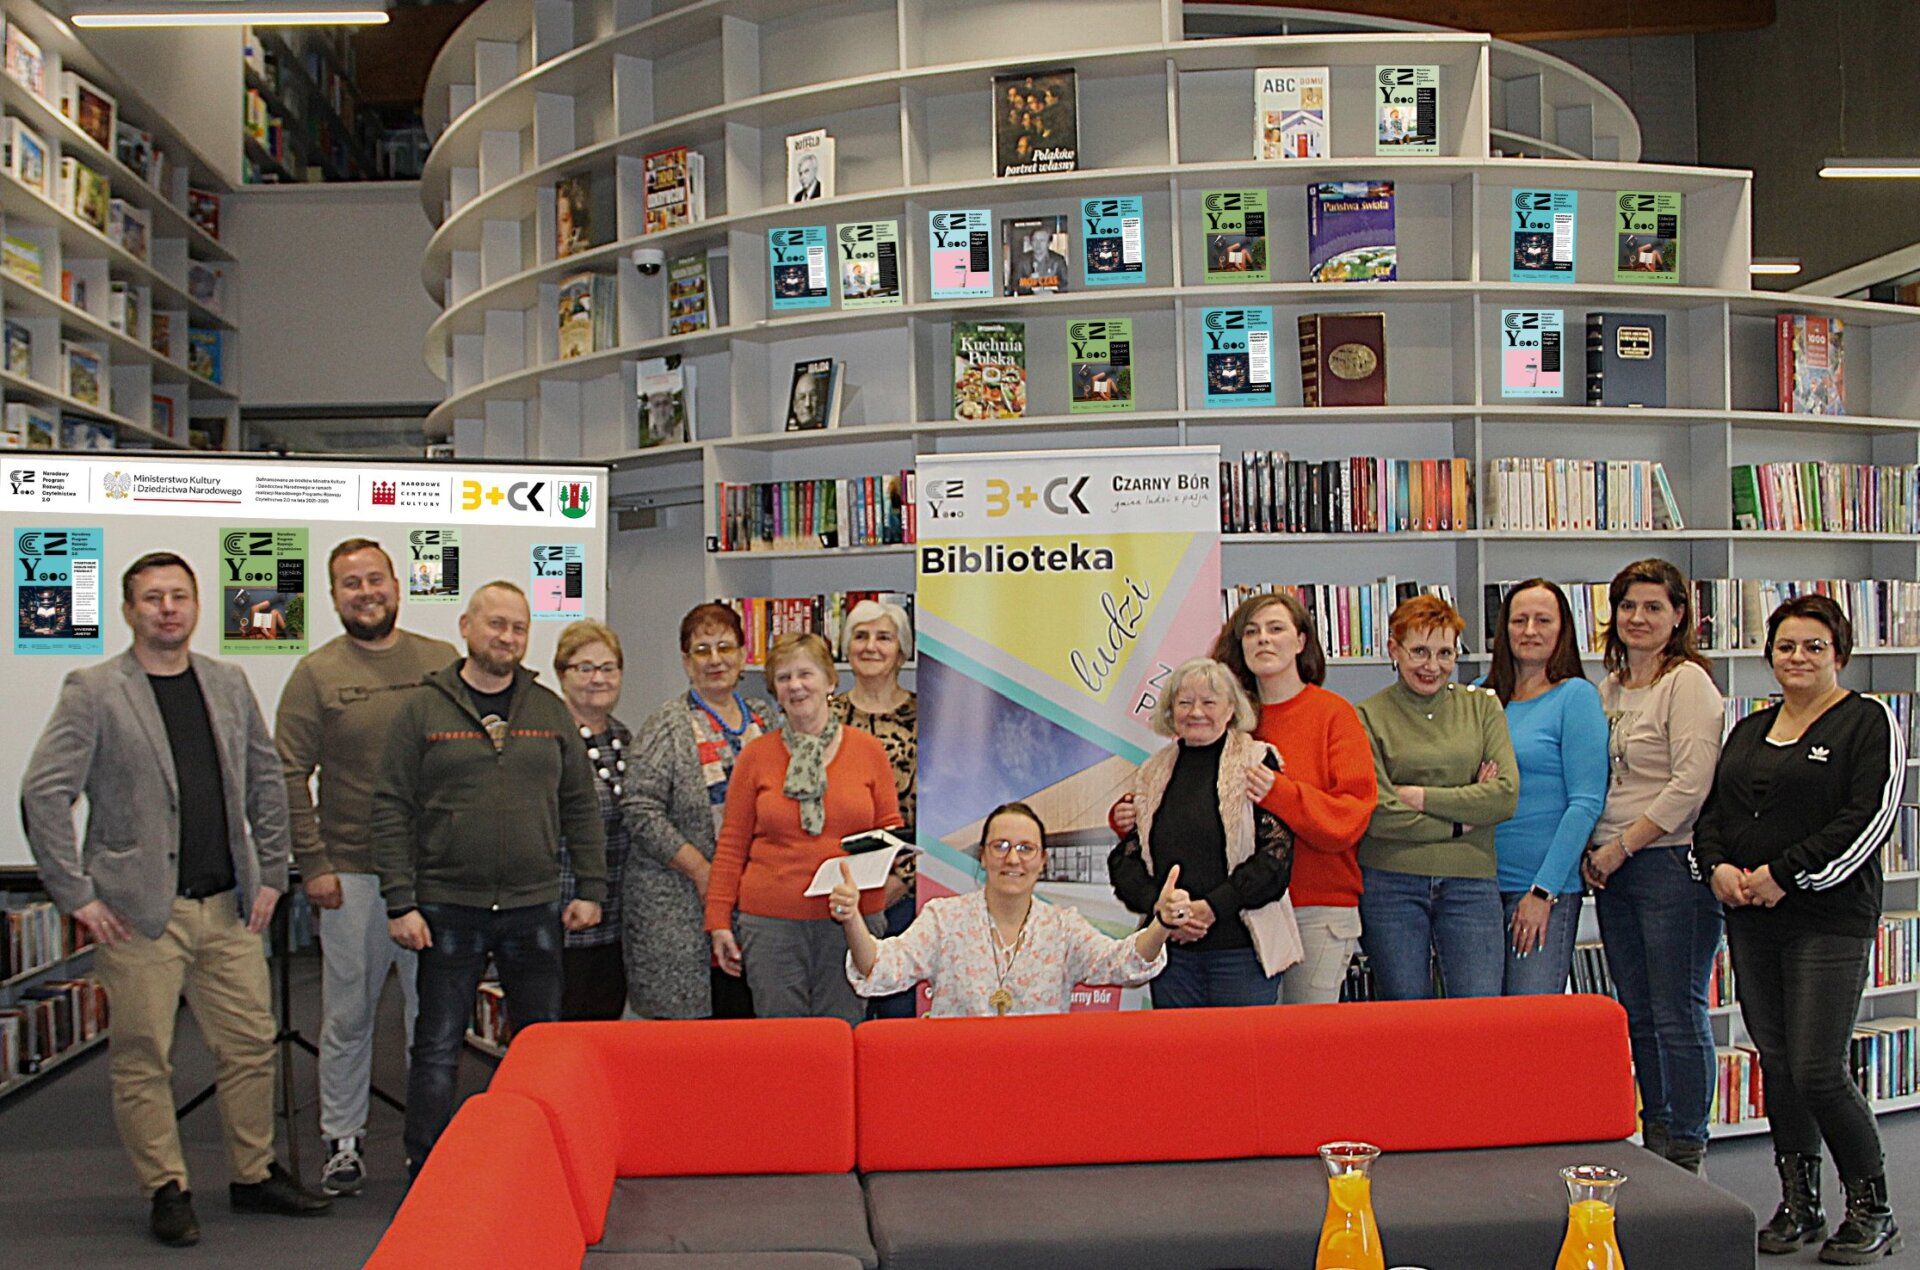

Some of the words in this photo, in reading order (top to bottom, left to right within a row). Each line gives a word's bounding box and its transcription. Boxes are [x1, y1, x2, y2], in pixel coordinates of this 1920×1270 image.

[1263, 78, 1296, 93] ABC
[1032, 147, 1075, 162] Polaków
[1005, 163, 1038, 177] portret
[1039, 160, 1075, 172] własny
[1323, 202, 1359, 212] Państwa
[1361, 200, 1389, 210] świata
[960, 337, 1023, 351] Kuchnia
[969, 351, 1015, 366] Polska
[133, 474, 188, 484] Ministerstwo
[190, 476, 221, 486] Kultury
[138, 484, 188, 494] Dziedzictwa
[189, 486, 242, 496] Narodowego
[921, 542, 1114, 574] Biblioteka
[1070, 576, 1151, 692] ludzi
[1093, 989, 1112, 1004] Bór
